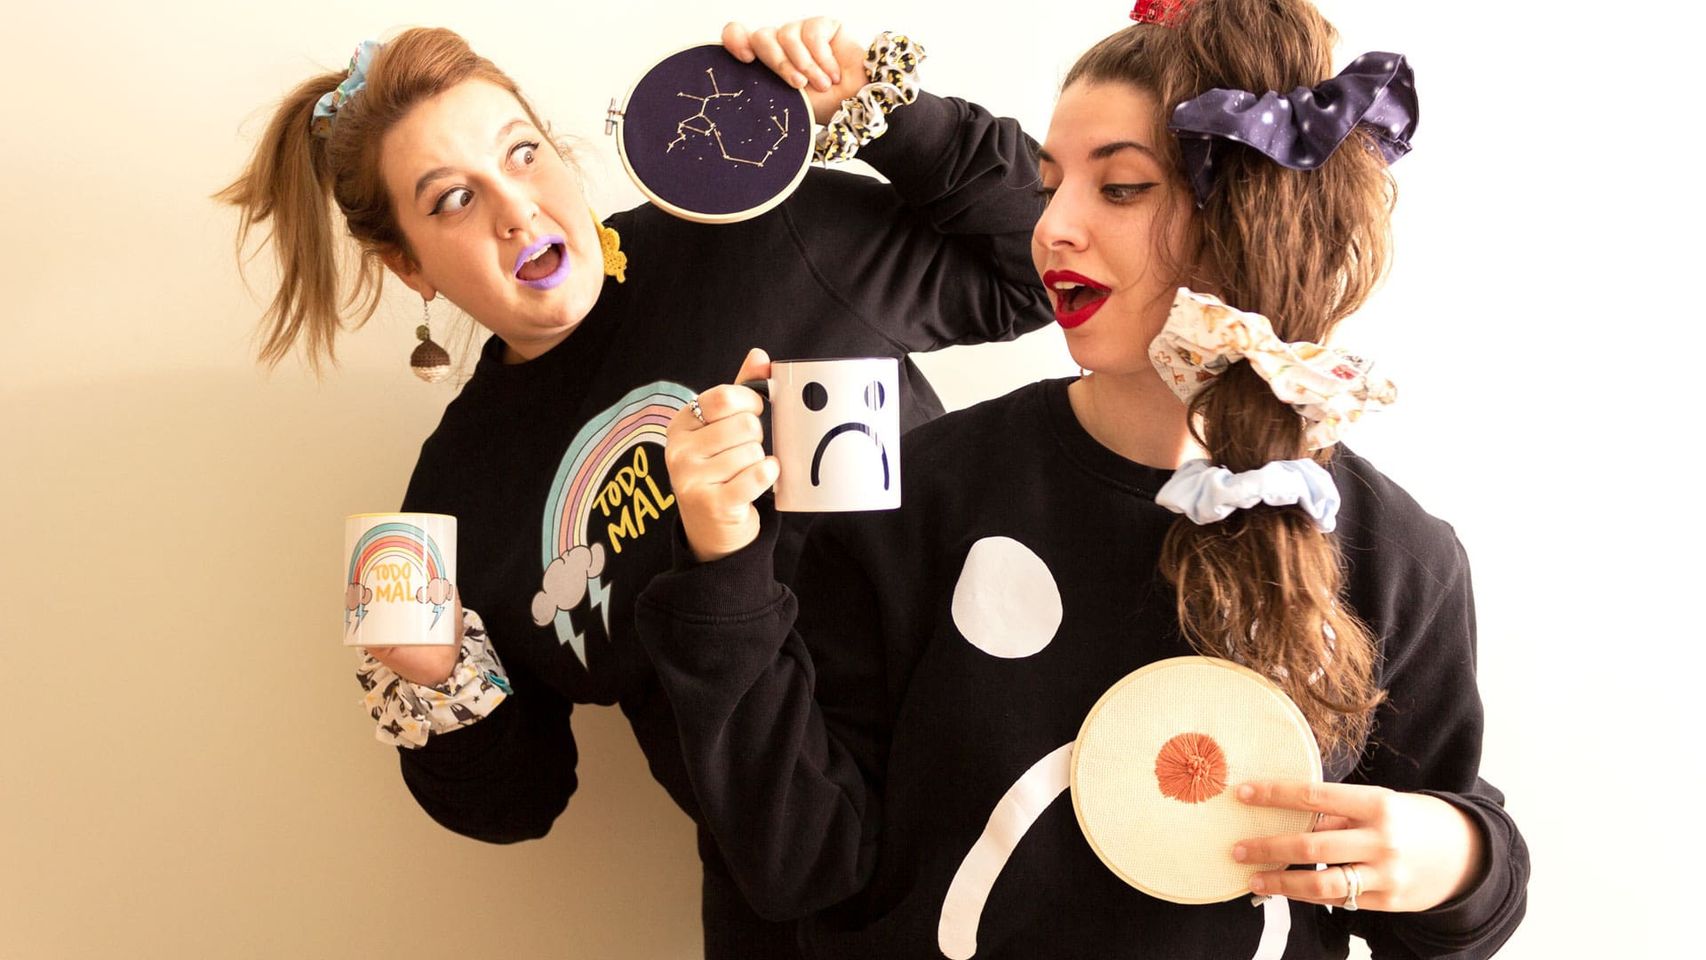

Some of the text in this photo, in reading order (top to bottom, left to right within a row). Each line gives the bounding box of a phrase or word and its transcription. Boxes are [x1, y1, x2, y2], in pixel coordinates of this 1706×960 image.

[593, 445, 649, 517] TODO
[607, 475, 675, 554] MAL
[371, 562, 412, 580] TODO
[375, 580, 416, 603] MAL
